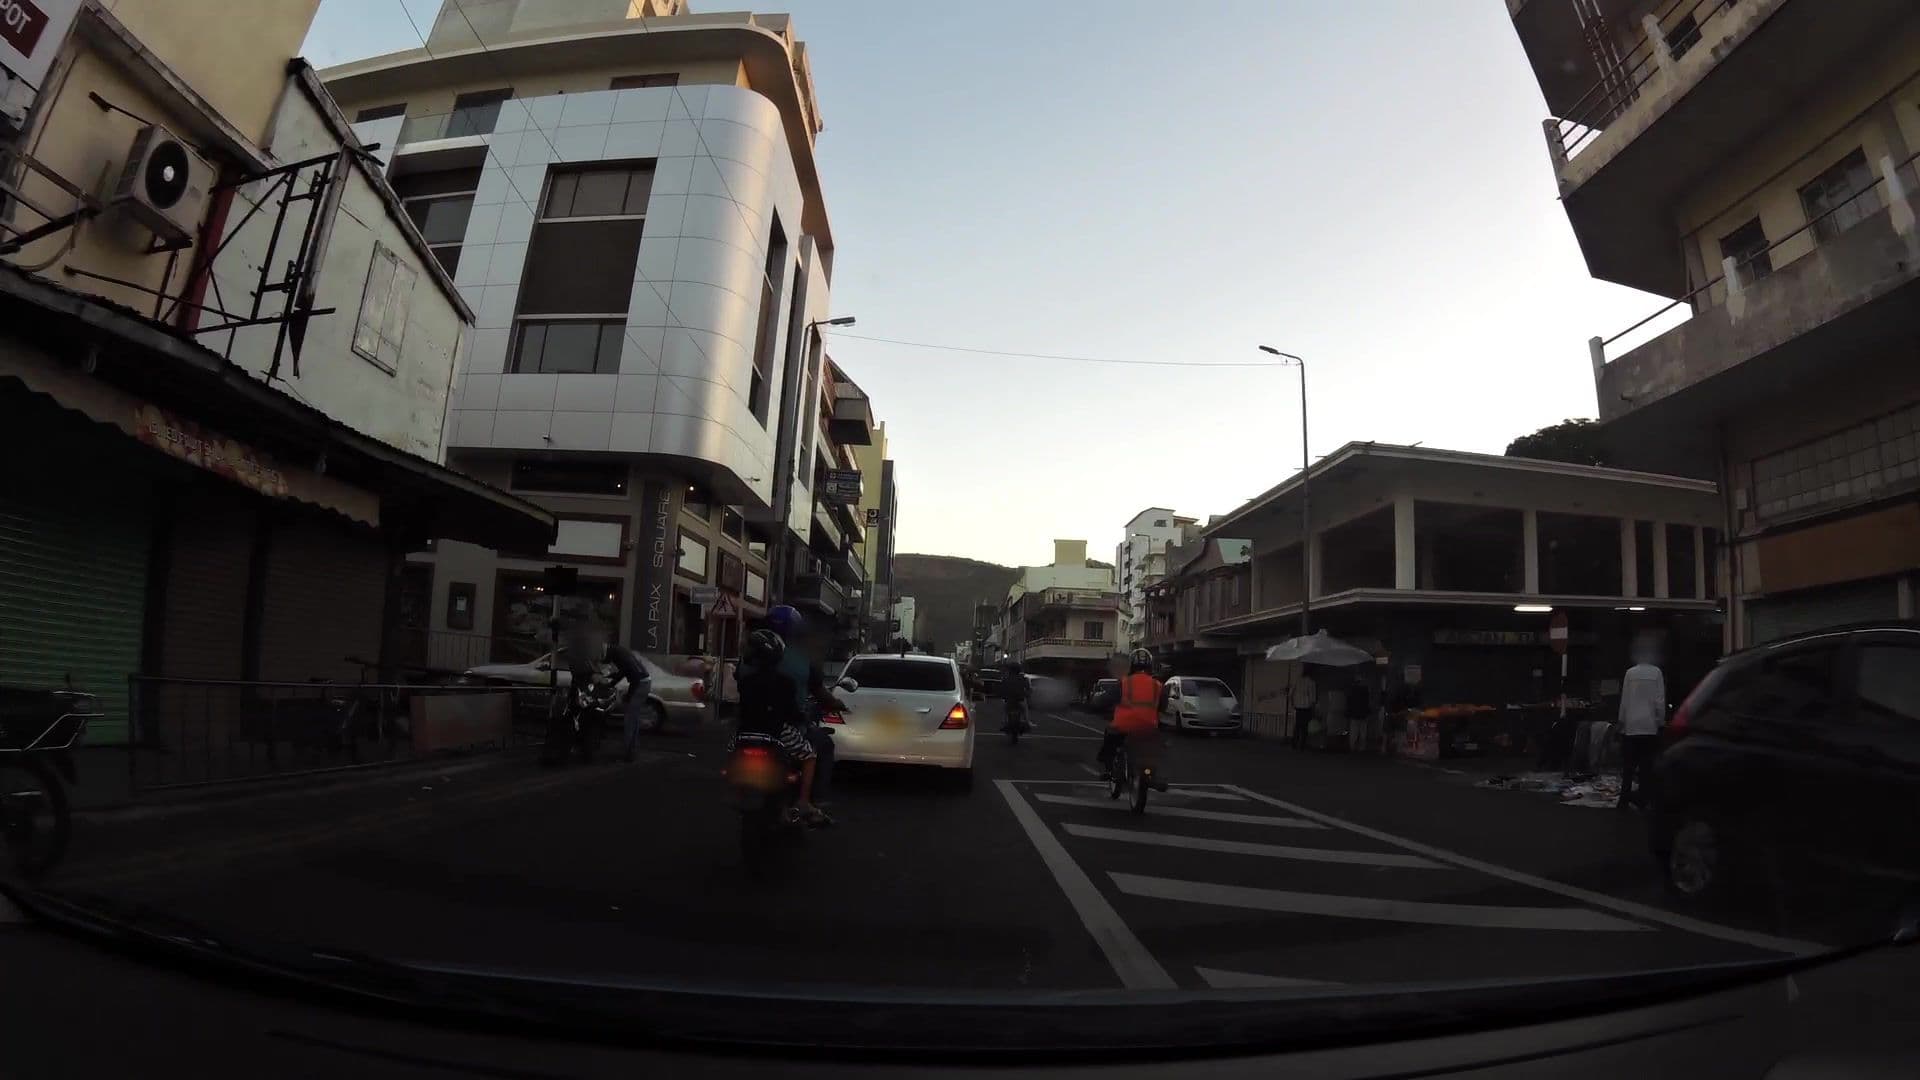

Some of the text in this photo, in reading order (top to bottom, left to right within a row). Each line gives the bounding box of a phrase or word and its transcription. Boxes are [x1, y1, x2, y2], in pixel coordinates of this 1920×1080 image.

[648, 487, 672, 649] LA PAIX SQUARE
